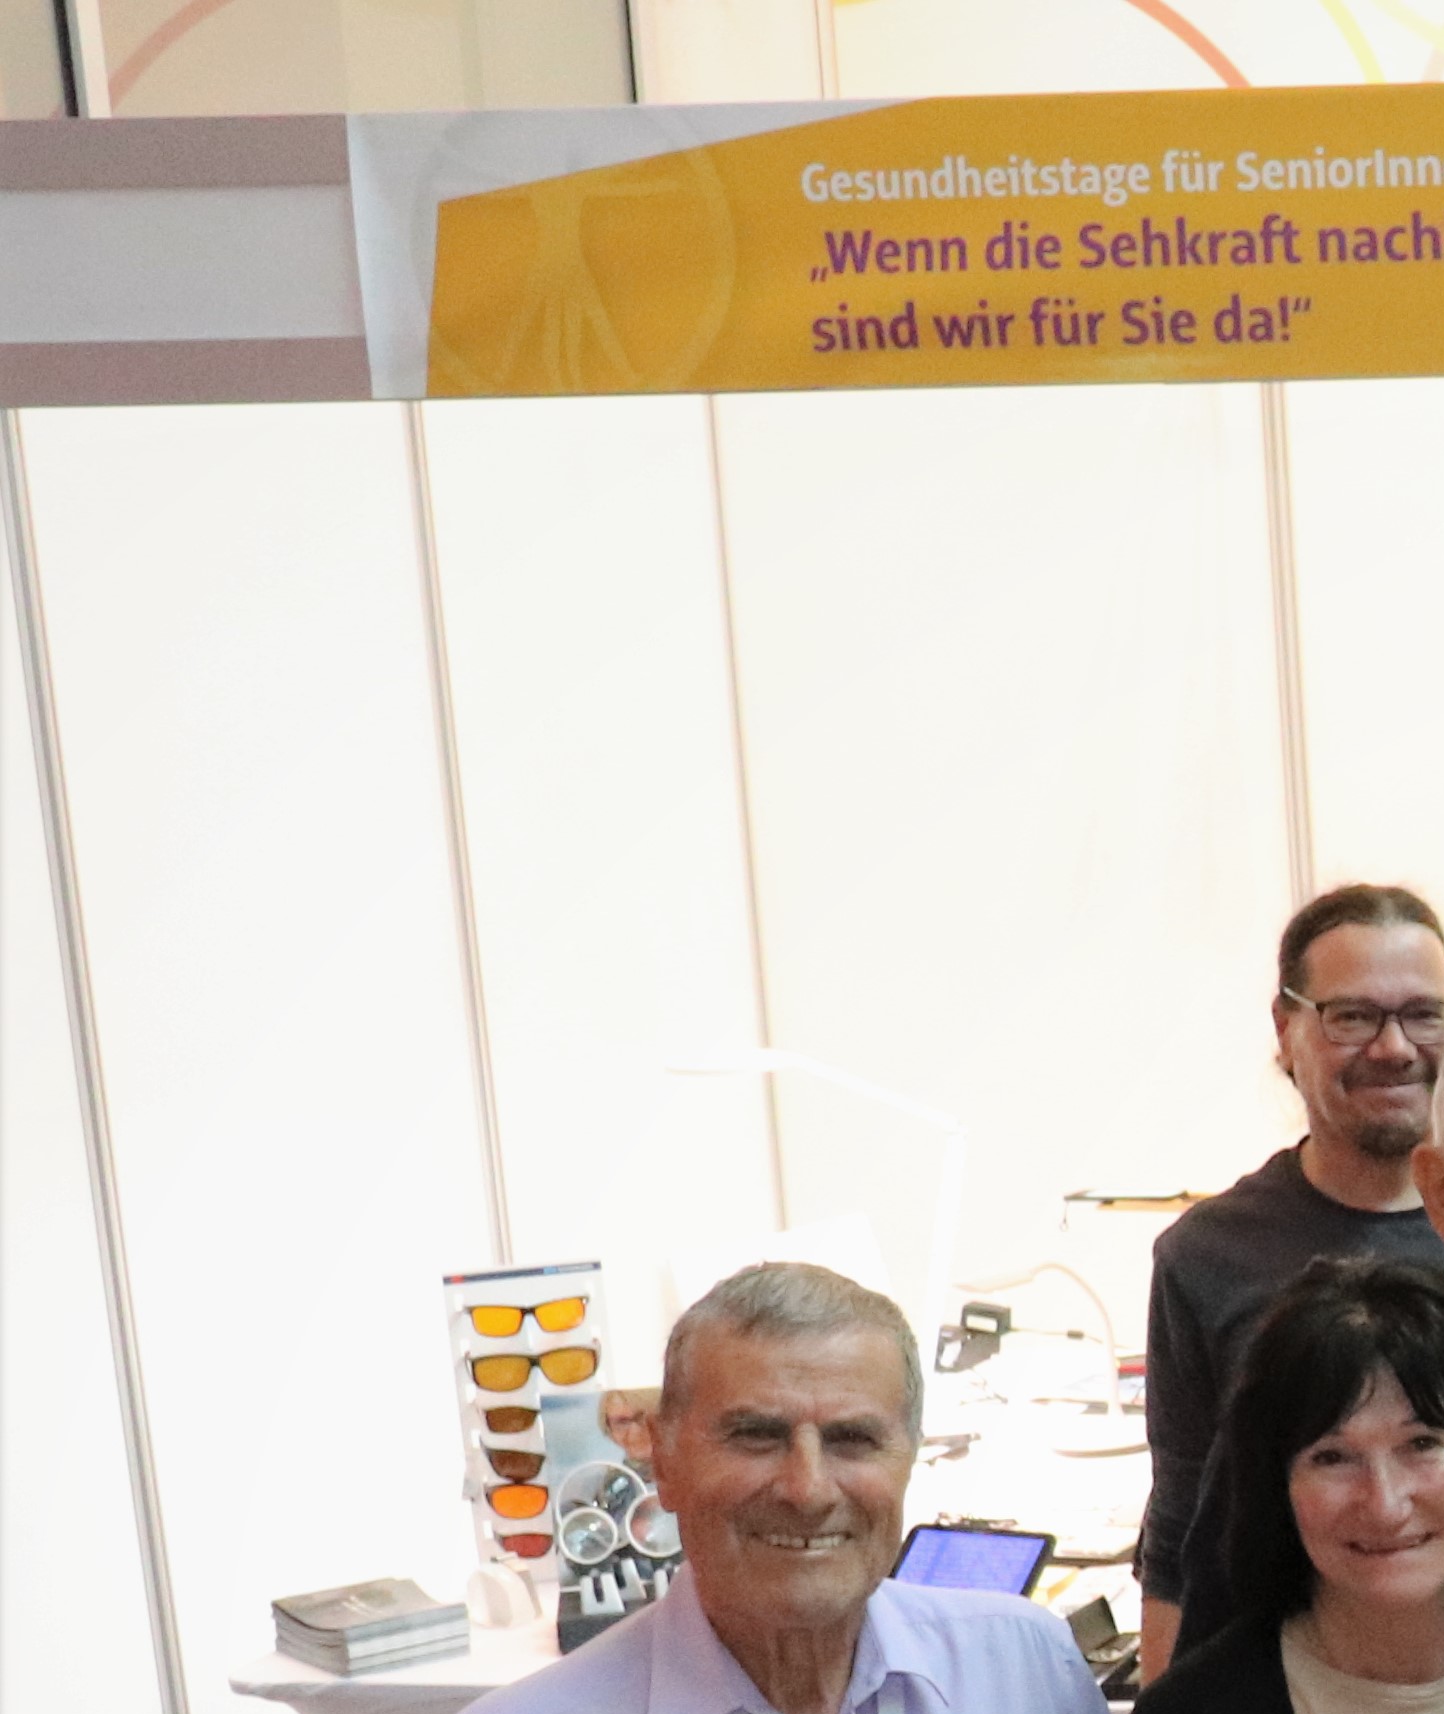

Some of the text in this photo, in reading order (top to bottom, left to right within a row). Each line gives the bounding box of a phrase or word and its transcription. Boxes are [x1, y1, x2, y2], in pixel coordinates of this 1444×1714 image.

[802, 155, 1150, 207] Gesundheitstage
[1162, 149, 1225, 194] für
[985, 220, 1062, 271] die
[1079, 212, 1301, 269] Sehkraft
[812, 300, 919, 352] sind
[933, 299, 1014, 349] wir
[1029, 297, 1105, 347] für
[1121, 296, 1197, 346] Sie
